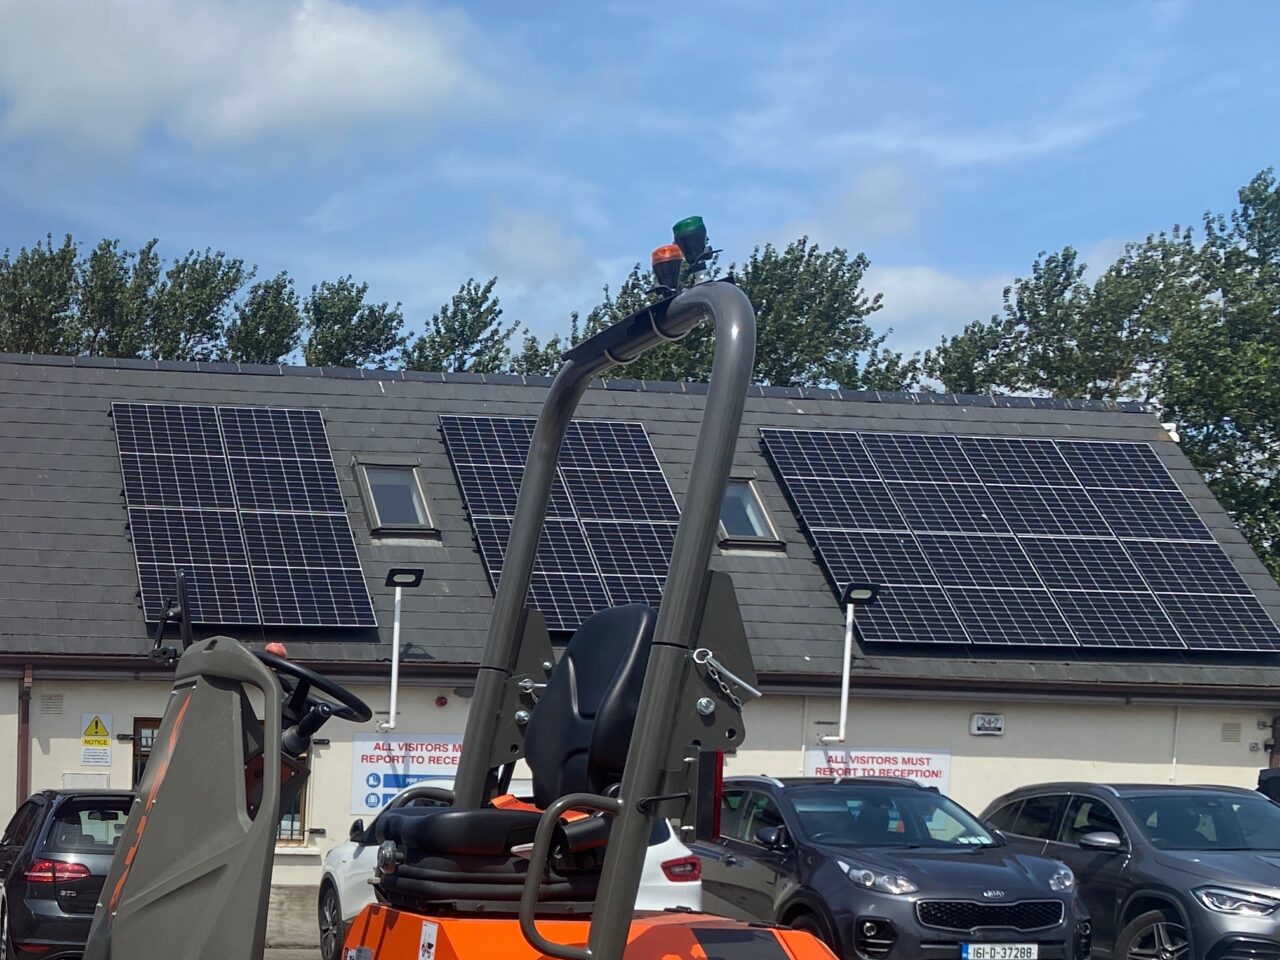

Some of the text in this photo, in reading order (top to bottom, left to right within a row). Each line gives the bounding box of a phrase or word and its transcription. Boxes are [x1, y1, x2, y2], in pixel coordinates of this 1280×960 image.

[374, 742, 394, 751] ALL
[398, 743, 449, 752] VISITORS
[361, 754, 407, 764] REPORT
[411, 755, 425, 764] TO
[827, 755, 932, 766] ALL VISITORS MUST
[815, 767, 942, 779] REPORT TO RECEPTION!
[972, 947, 1032, 959] 161-D-37288
